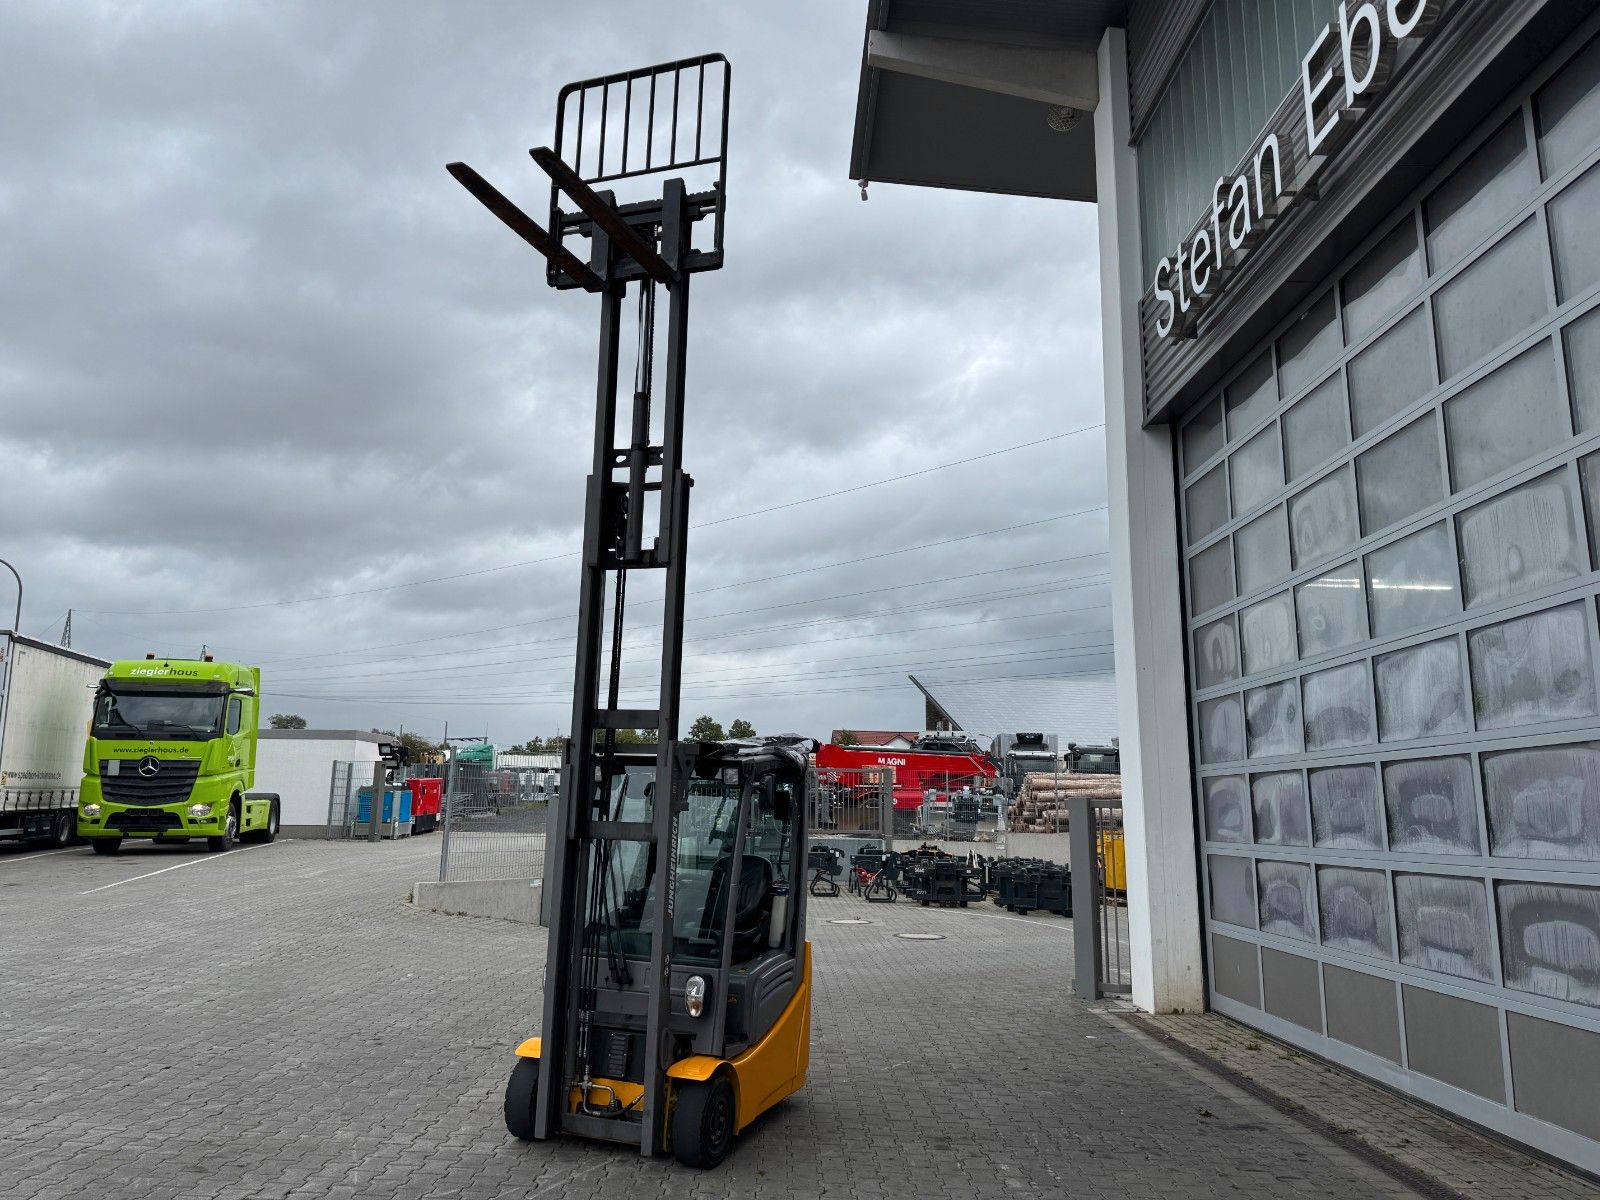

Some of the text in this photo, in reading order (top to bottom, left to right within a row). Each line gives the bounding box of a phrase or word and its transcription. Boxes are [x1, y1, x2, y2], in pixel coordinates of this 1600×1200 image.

[1154, 133, 1282, 338] Stefan
[130, 666, 198, 677] zieglerhaus
[113, 746, 189, 755] www.zieglerhaus.de
[877, 757, 906, 766] MAGNI
[667, 817, 678, 918] JUNGHEINRICH
